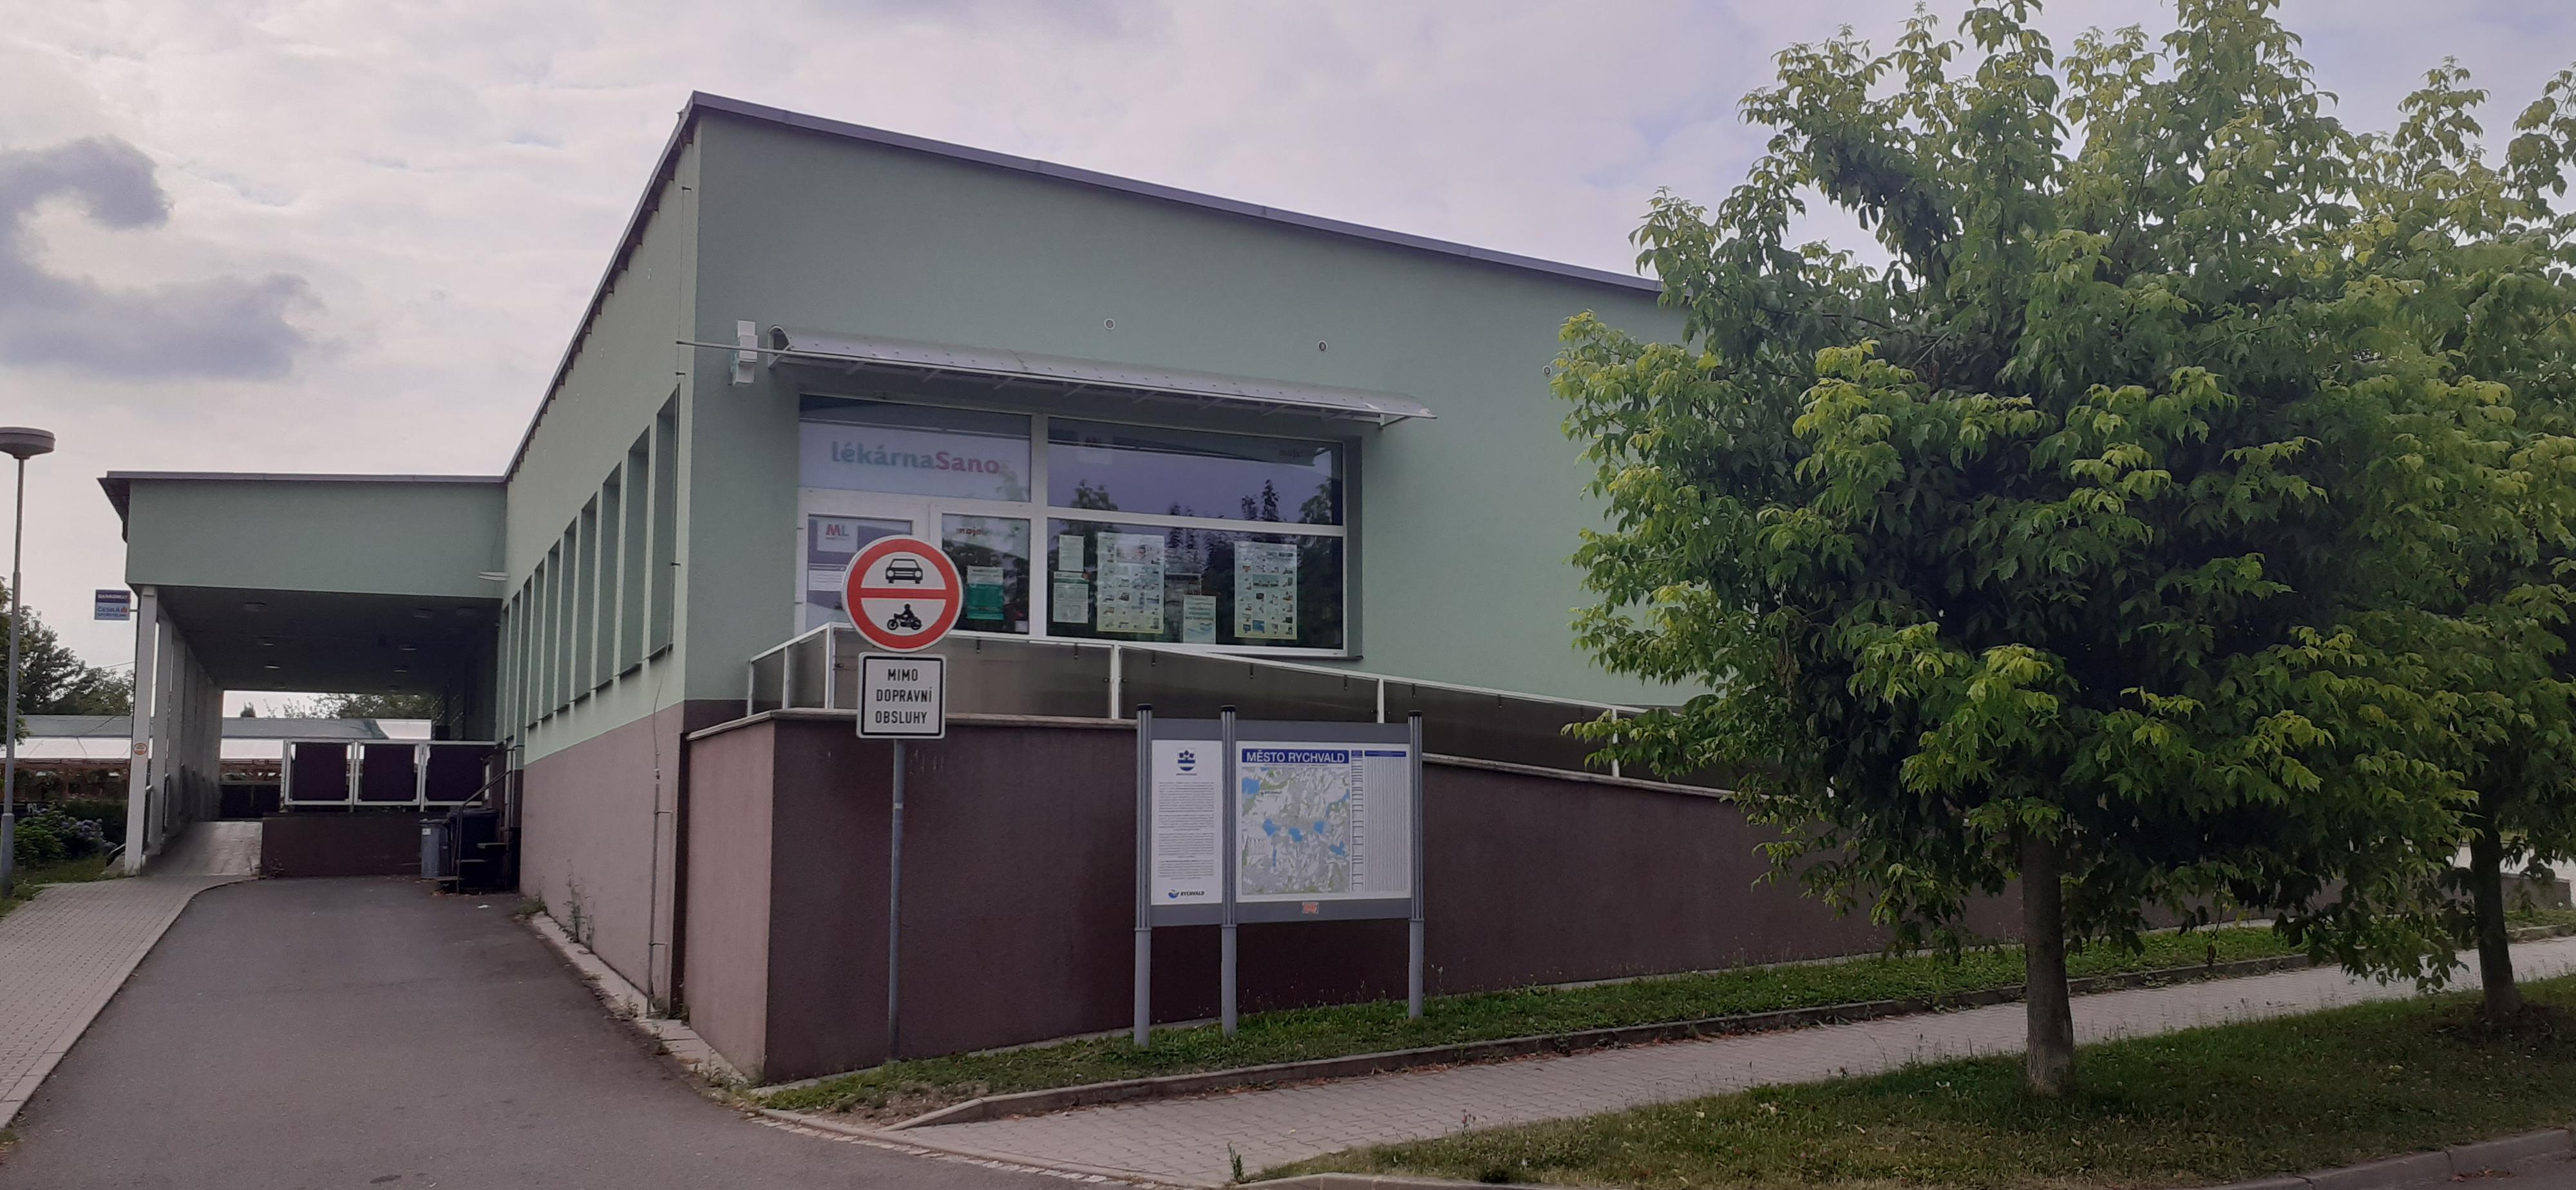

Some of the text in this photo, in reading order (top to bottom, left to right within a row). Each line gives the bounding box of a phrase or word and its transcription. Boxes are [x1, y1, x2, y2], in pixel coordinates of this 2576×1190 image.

[831, 441, 1000, 474] lékárnaSano
[887, 668, 918, 681] MIMO
[876, 686, 933, 703] DOPRAVNÍ
[875, 710, 928, 724] OBSLUHY
[1246, 750, 1345, 763] MĚSTO RYCHVALD
